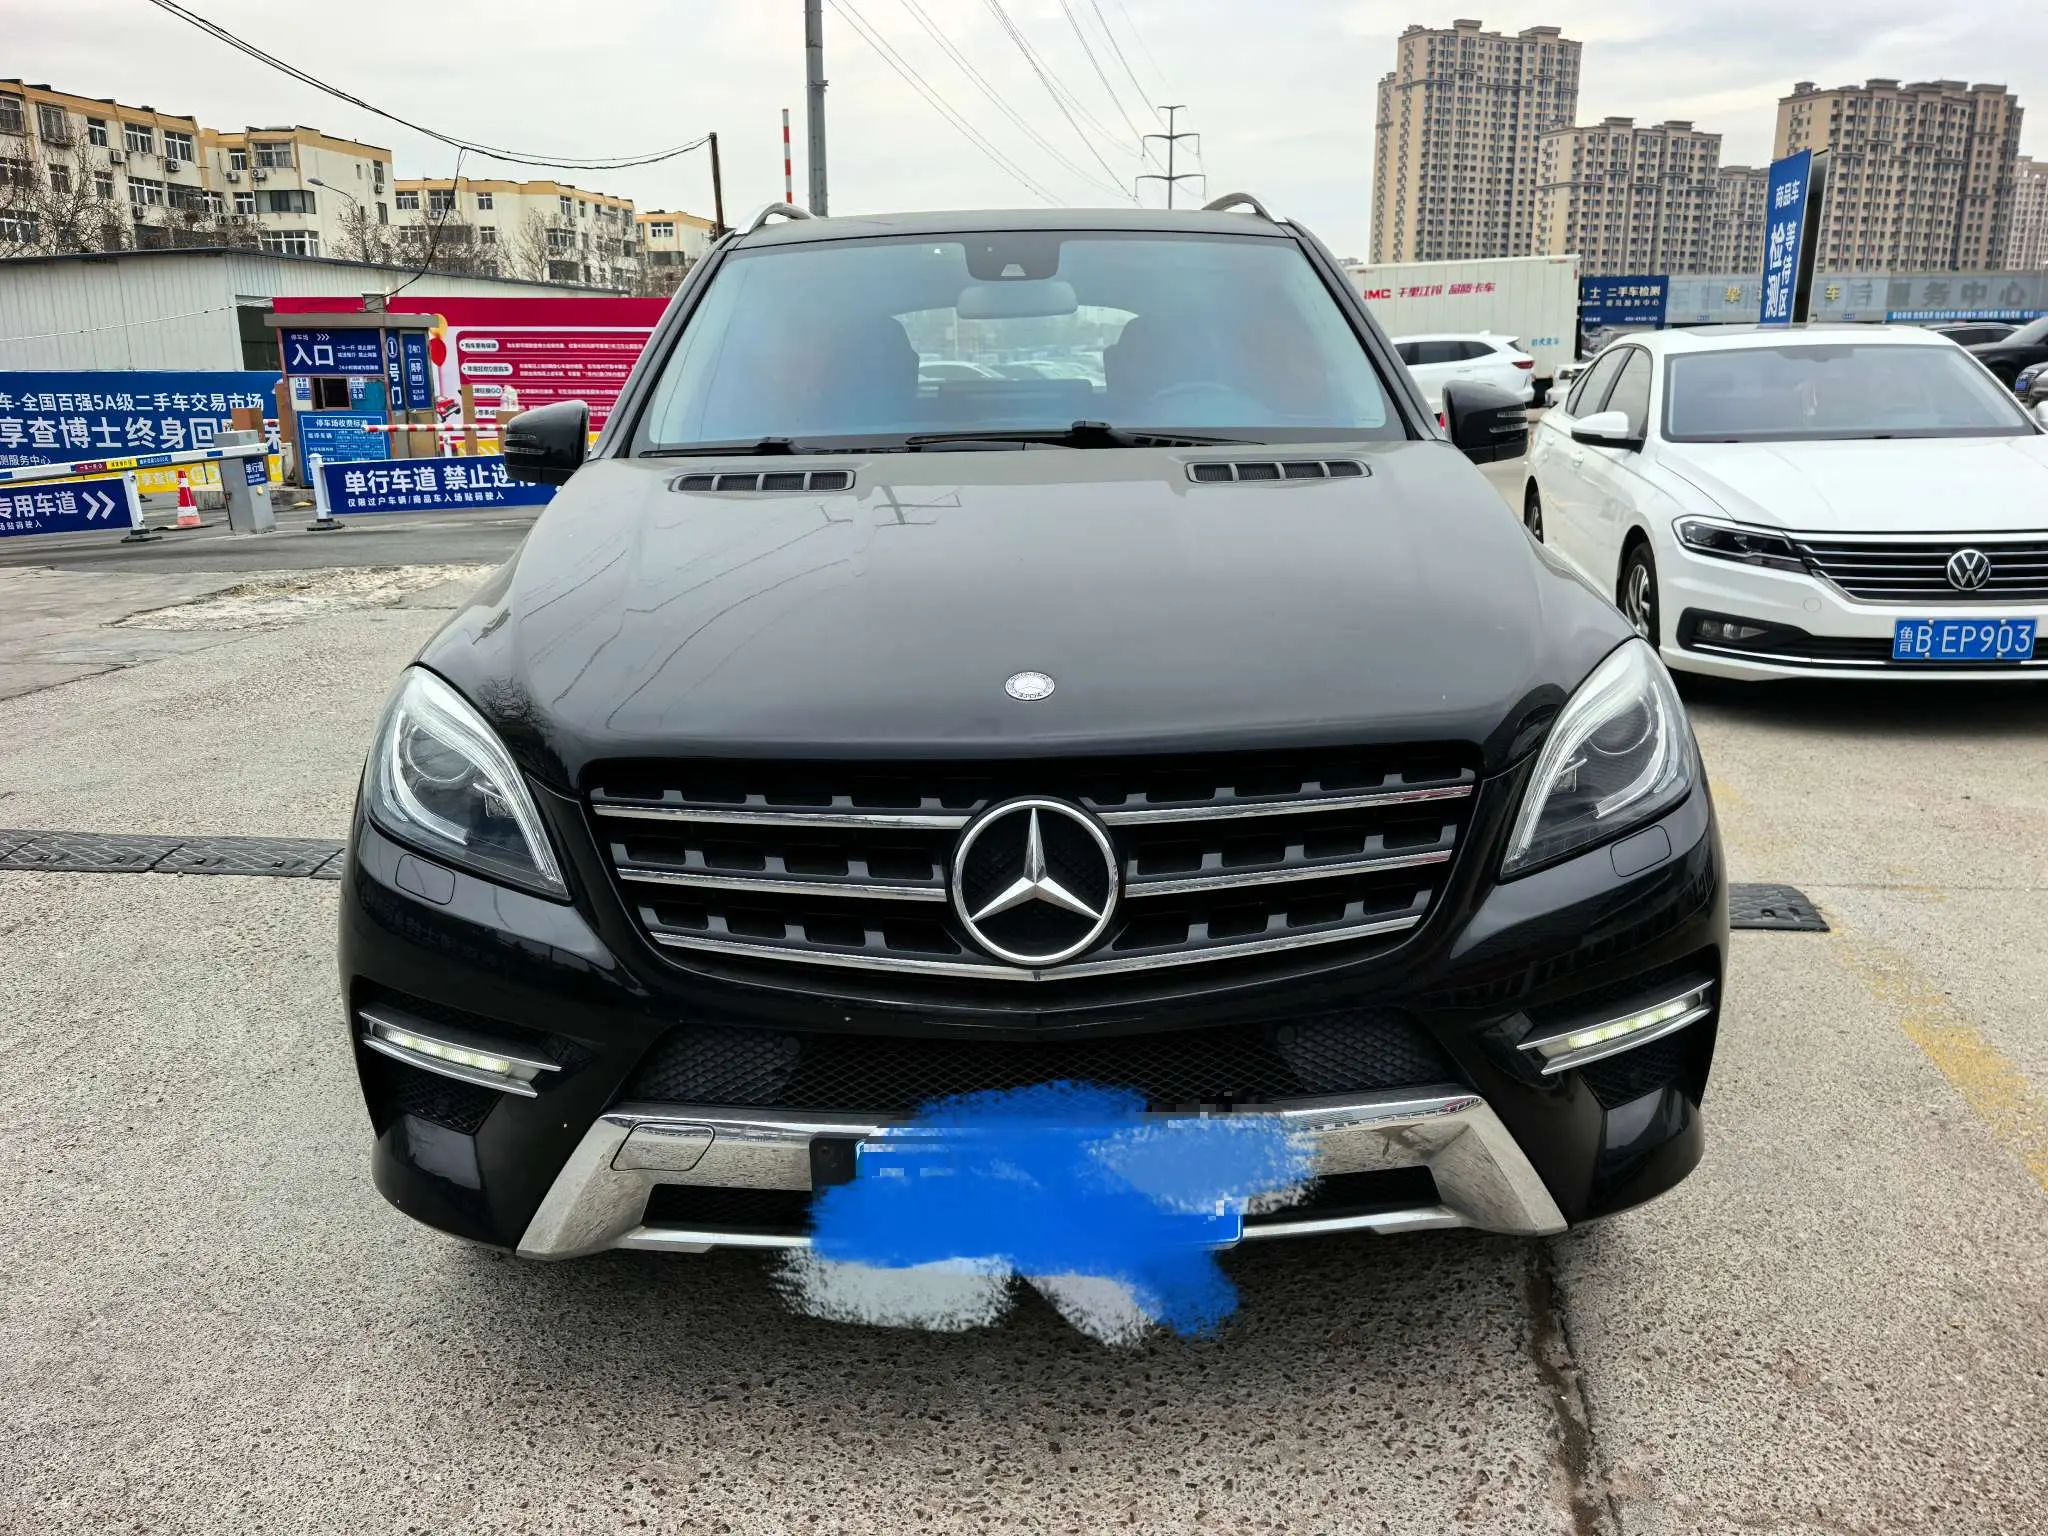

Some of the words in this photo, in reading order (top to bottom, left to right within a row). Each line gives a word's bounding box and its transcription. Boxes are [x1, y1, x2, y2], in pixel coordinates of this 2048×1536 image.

[1775, 179, 1800, 210] 商品车
[1765, 221, 1785, 319] 检测
[1778, 221, 1797, 317] 等待区
[292, 343, 334, 366] 入口
[0, 392, 264, 411] 车-全国百强5A级二手车交易市场
[245, 460, 265, 474] 单行道
[344, 467, 438, 495] 单行车道
